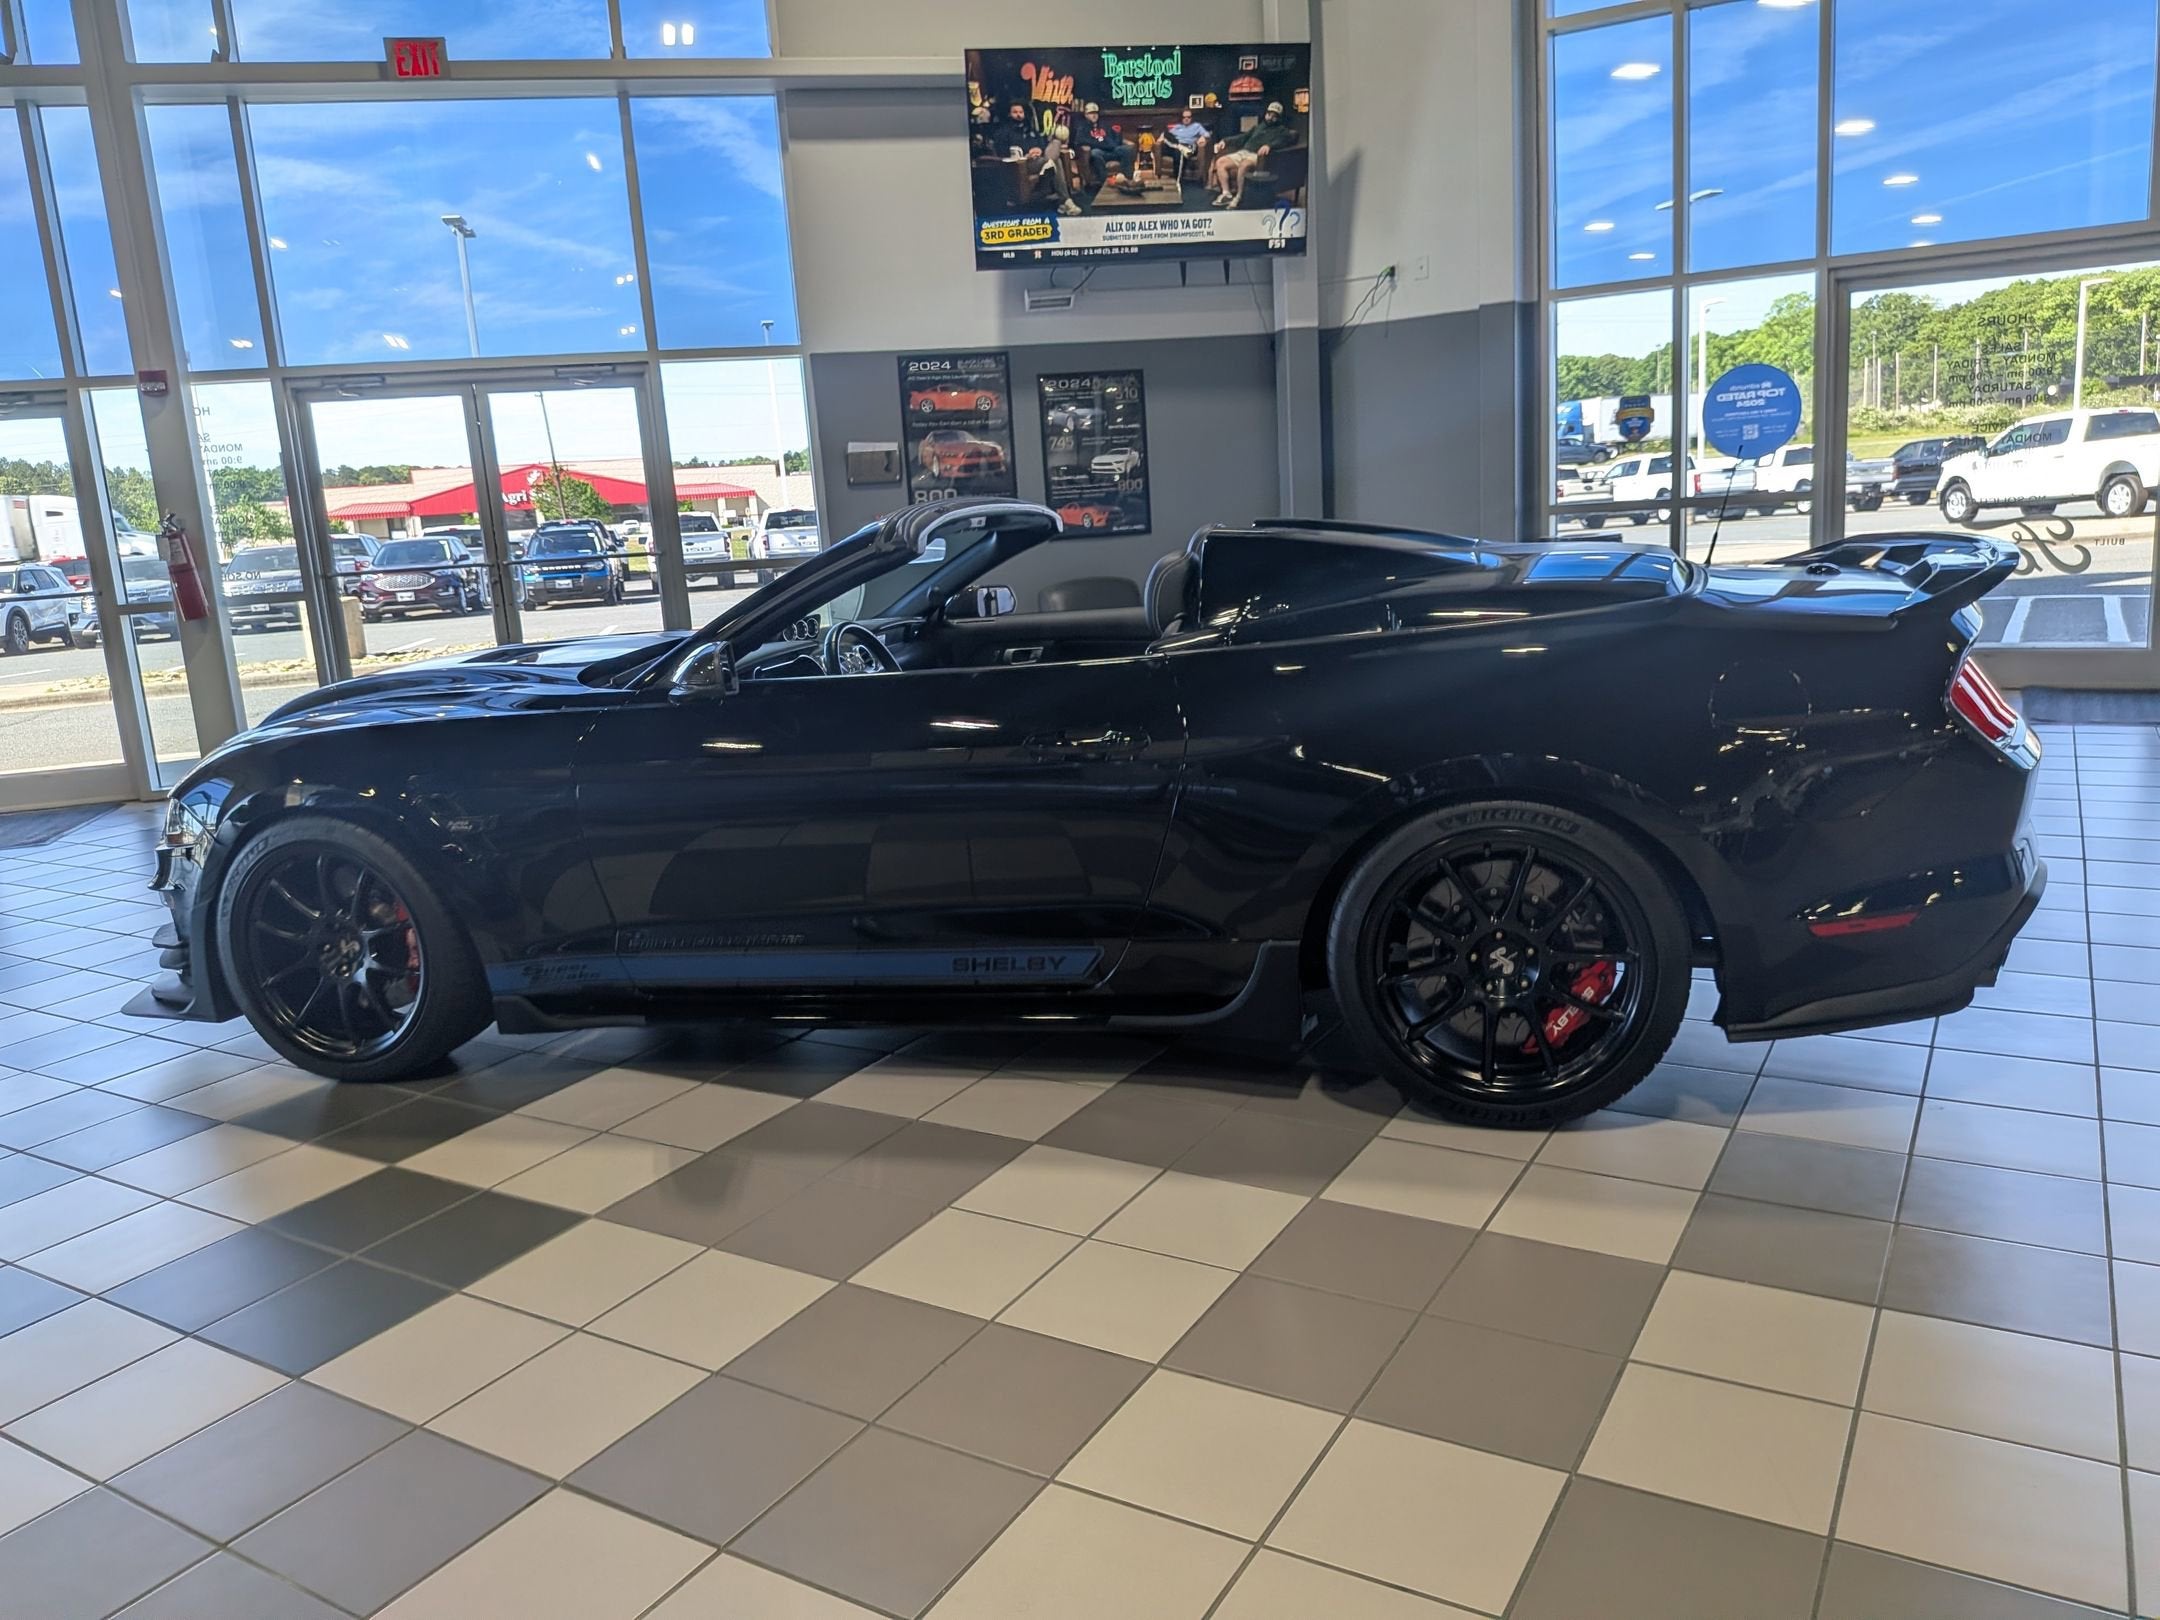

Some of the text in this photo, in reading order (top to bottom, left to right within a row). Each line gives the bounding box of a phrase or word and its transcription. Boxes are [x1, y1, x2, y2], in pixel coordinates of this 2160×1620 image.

[394, 41, 441, 78] EXIT
[1101, 50, 1182, 78] Barstool
[1111, 75, 1173, 106] Sports
[982, 216, 1050, 229] QUESTIONS FROM A
[1105, 218, 1212, 232] ALIX OR ALEX WHO YA GOT?
[984, 227, 1049, 240] 3RD GRADER
[908, 361, 951, 371] 2024
[1046, 378, 1091, 389] 2024
[952, 955, 1067, 972] SHELBY
